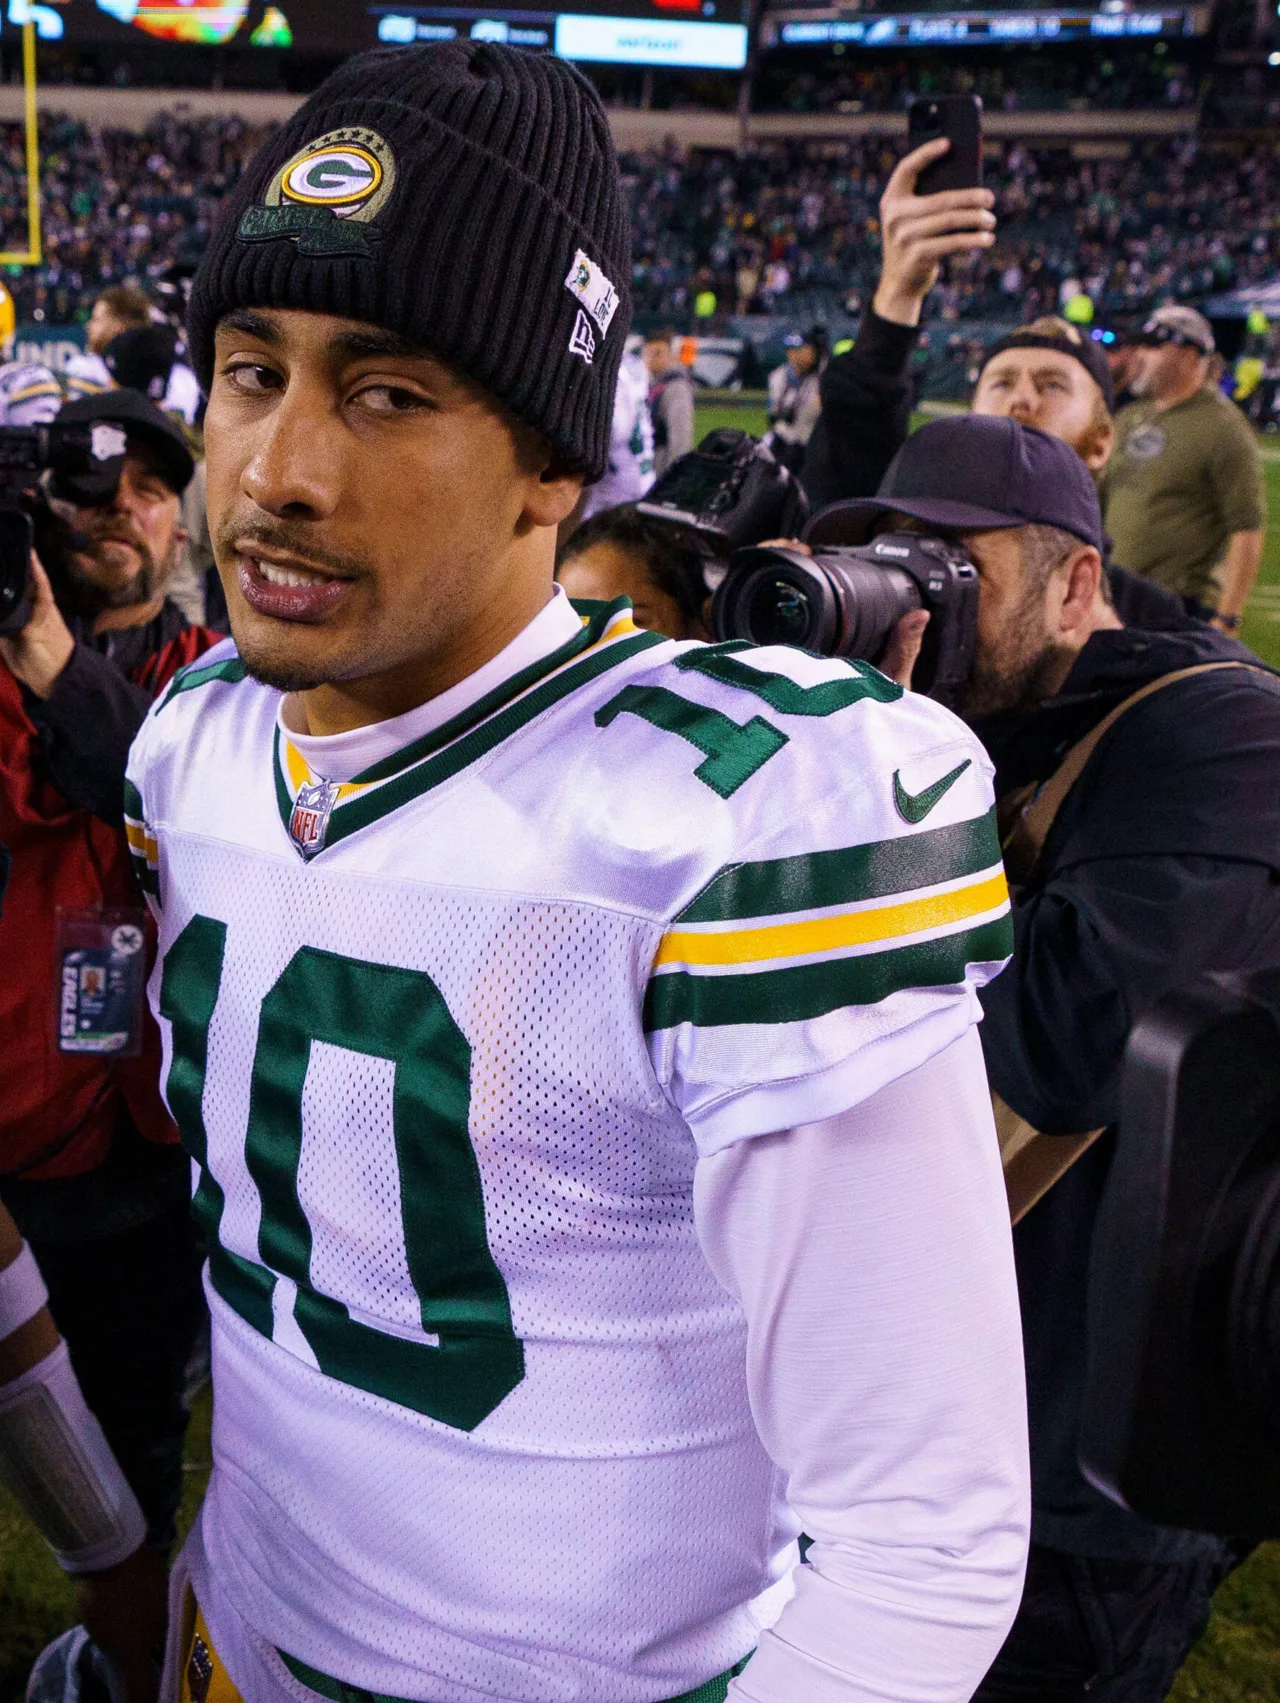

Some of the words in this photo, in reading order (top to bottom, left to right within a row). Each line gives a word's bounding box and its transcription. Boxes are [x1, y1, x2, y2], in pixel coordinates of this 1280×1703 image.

[875, 543, 911, 558] Canon
[593, 638, 905, 800] 10
[291, 809, 319, 845] NFL
[162, 913, 527, 1433] 10
